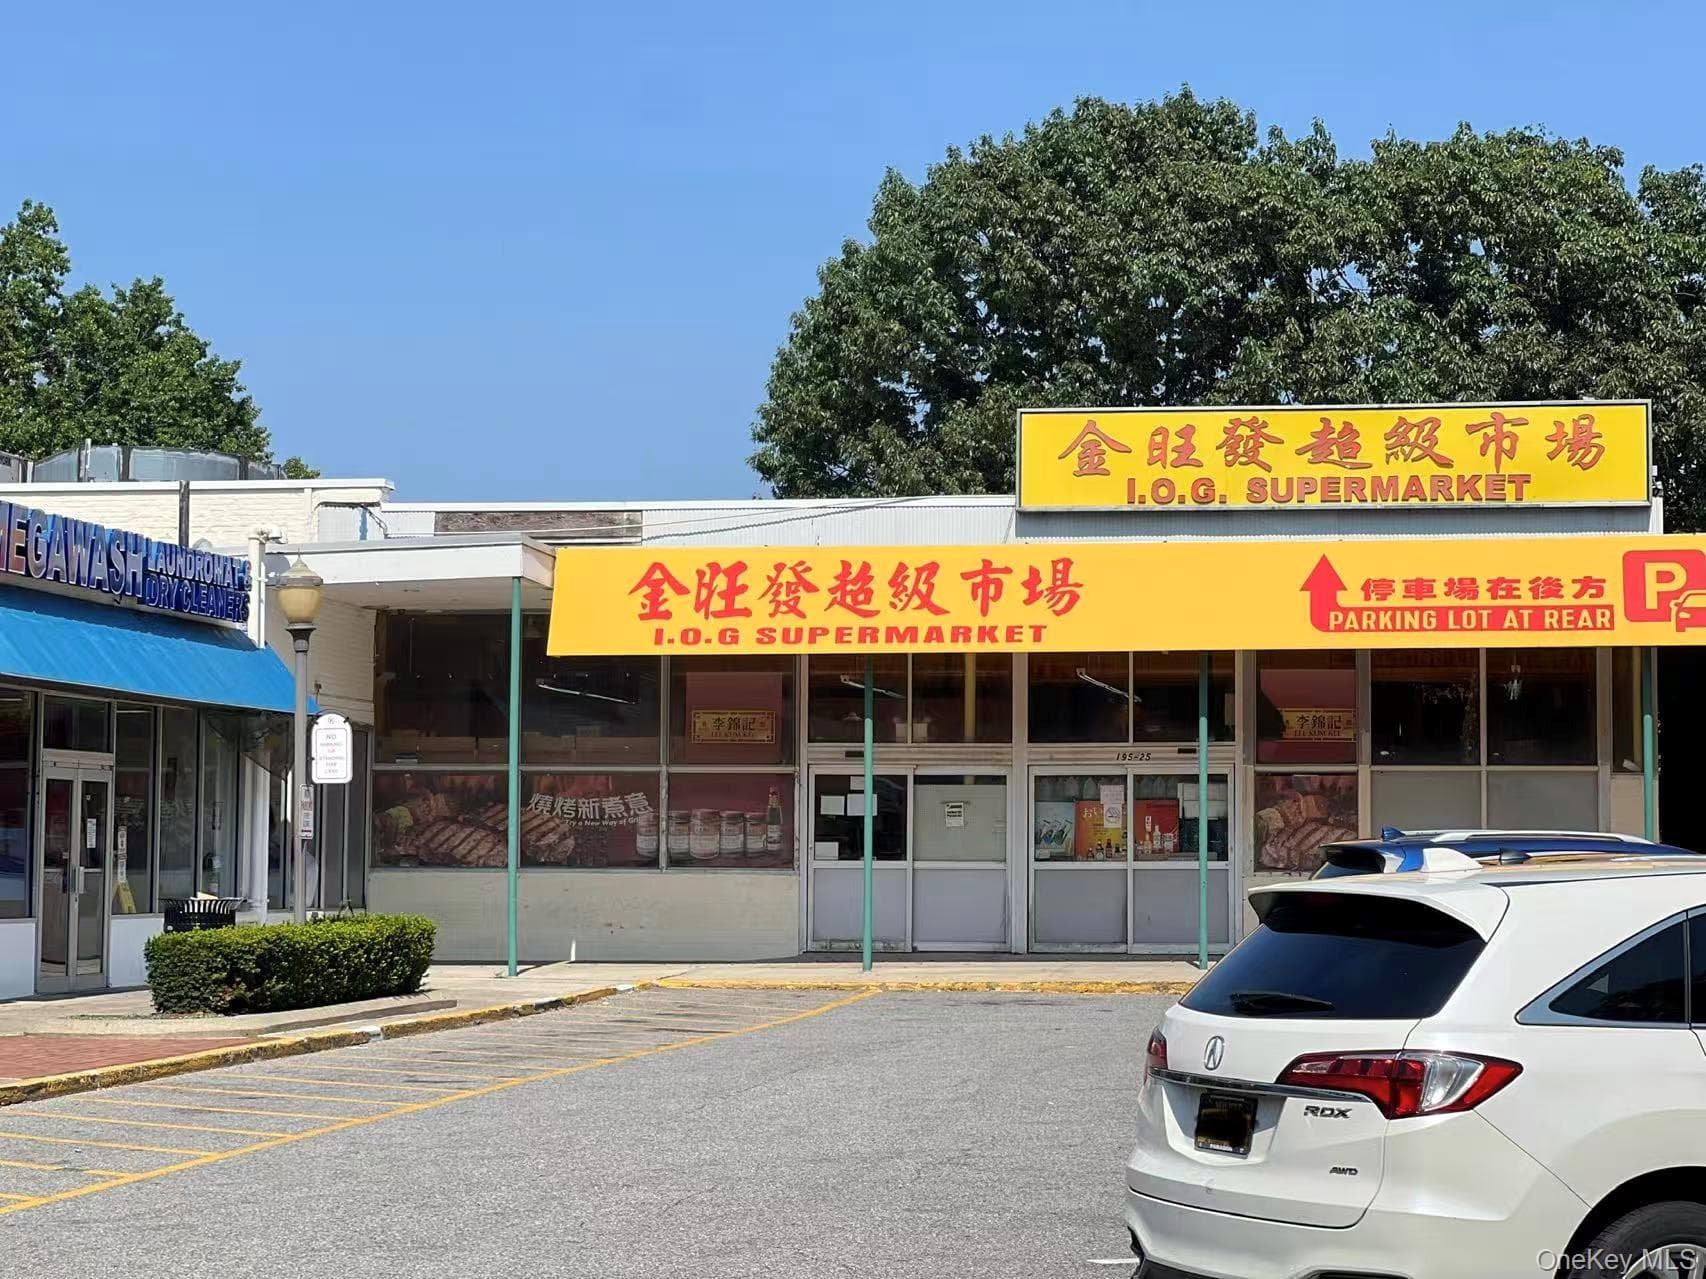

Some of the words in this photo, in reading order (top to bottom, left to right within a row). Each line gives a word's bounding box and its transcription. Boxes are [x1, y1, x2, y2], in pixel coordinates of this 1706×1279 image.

[1058, 411, 1606, 477] 金旺發超級市場
[1127, 477, 1227, 506] I.O.G.
[1246, 474, 1532, 504] SUPERMARKET
[146, 540, 241, 588] LAUNDROMAT
[146, 574, 176, 610] DRY
[181, 580, 250, 622] CLEANERS
[627, 557, 1084, 621] 金旺發超級市場
[1361, 576, 1607, 602] 停車場在後方
[1329, 609, 1437, 630] PARKING
[1447, 609, 1493, 630] LOT
[1503, 609, 1534, 629] AT
[1544, 608, 1612, 629] REAR
[654, 627, 742, 646] I.O.G
[756, 624, 1048, 645] SUPERMARKET
[1296, 714, 1342, 730] 李錦記
[1116, 752, 1152, 762] 195-25
[1304, 1105, 1353, 1121] RDX
[1329, 1167, 1358, 1176] AWD
